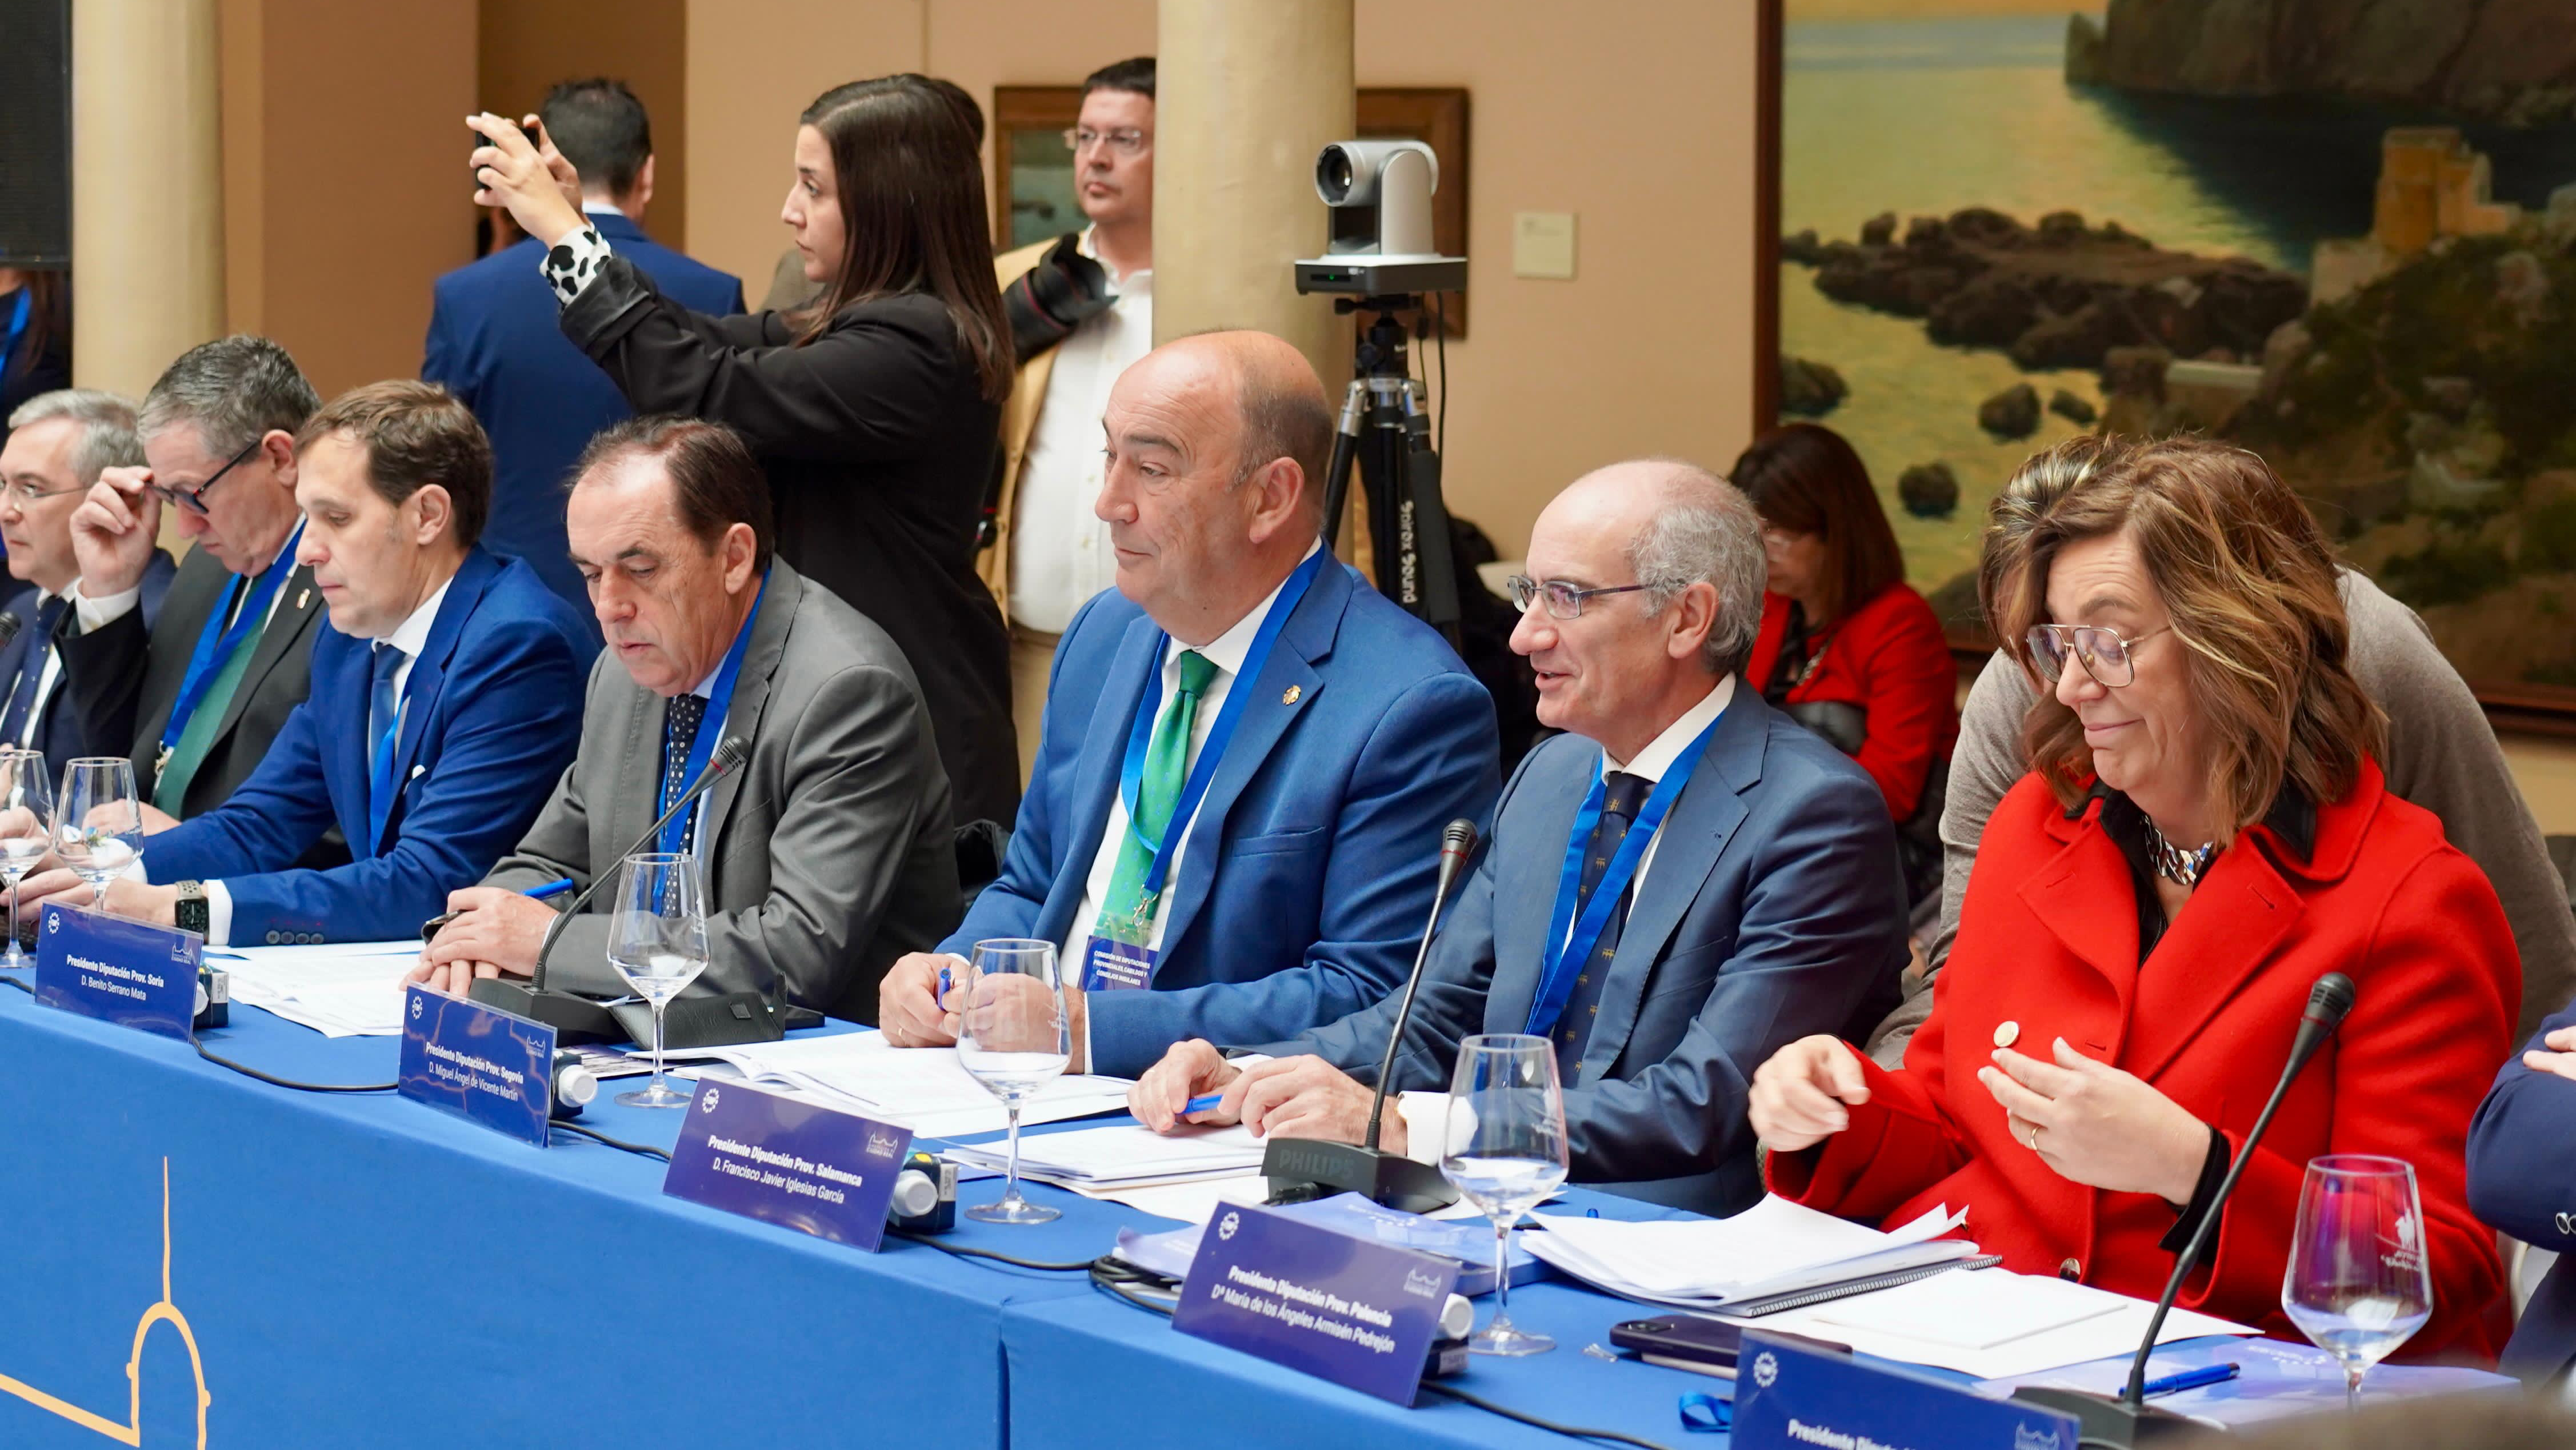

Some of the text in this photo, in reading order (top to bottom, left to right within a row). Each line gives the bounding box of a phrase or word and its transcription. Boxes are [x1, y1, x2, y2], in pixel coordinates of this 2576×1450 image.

[1401, 553, 1418, 603] Sound
[67, 954, 164, 988] Presidente Diputación Prov. Soria
[81, 975, 146, 1000] D. Benito Serrano Mata
[426, 1042, 523, 1084] Presidente Diputación Prov. Segovia
[429, 1062, 518, 1102] D. Miguel Ángel de Vicente Martín
[707, 1135, 863, 1187] Presidente Diputación Prov. Salamanca
[713, 1157, 845, 1204] D. Francisco Javier Iglesias García
[1279, 1149, 1354, 1179] PHILIPS
[1223, 1288, 1250, 1309] María
[1250, 1296, 1263, 1313] de
[1262, 1299, 1278, 1318] los
[1277, 1302, 1315, 1329] Ángeles
[1314, 1316, 1353, 1341] Armisén
[1353, 1326, 1395, 1354] Pedrejón
[1276, 1279, 1326, 1307] Diputación
[1325, 1294, 1350, 1315] Prov.
[1349, 1301, 1393, 1328] Palencia
